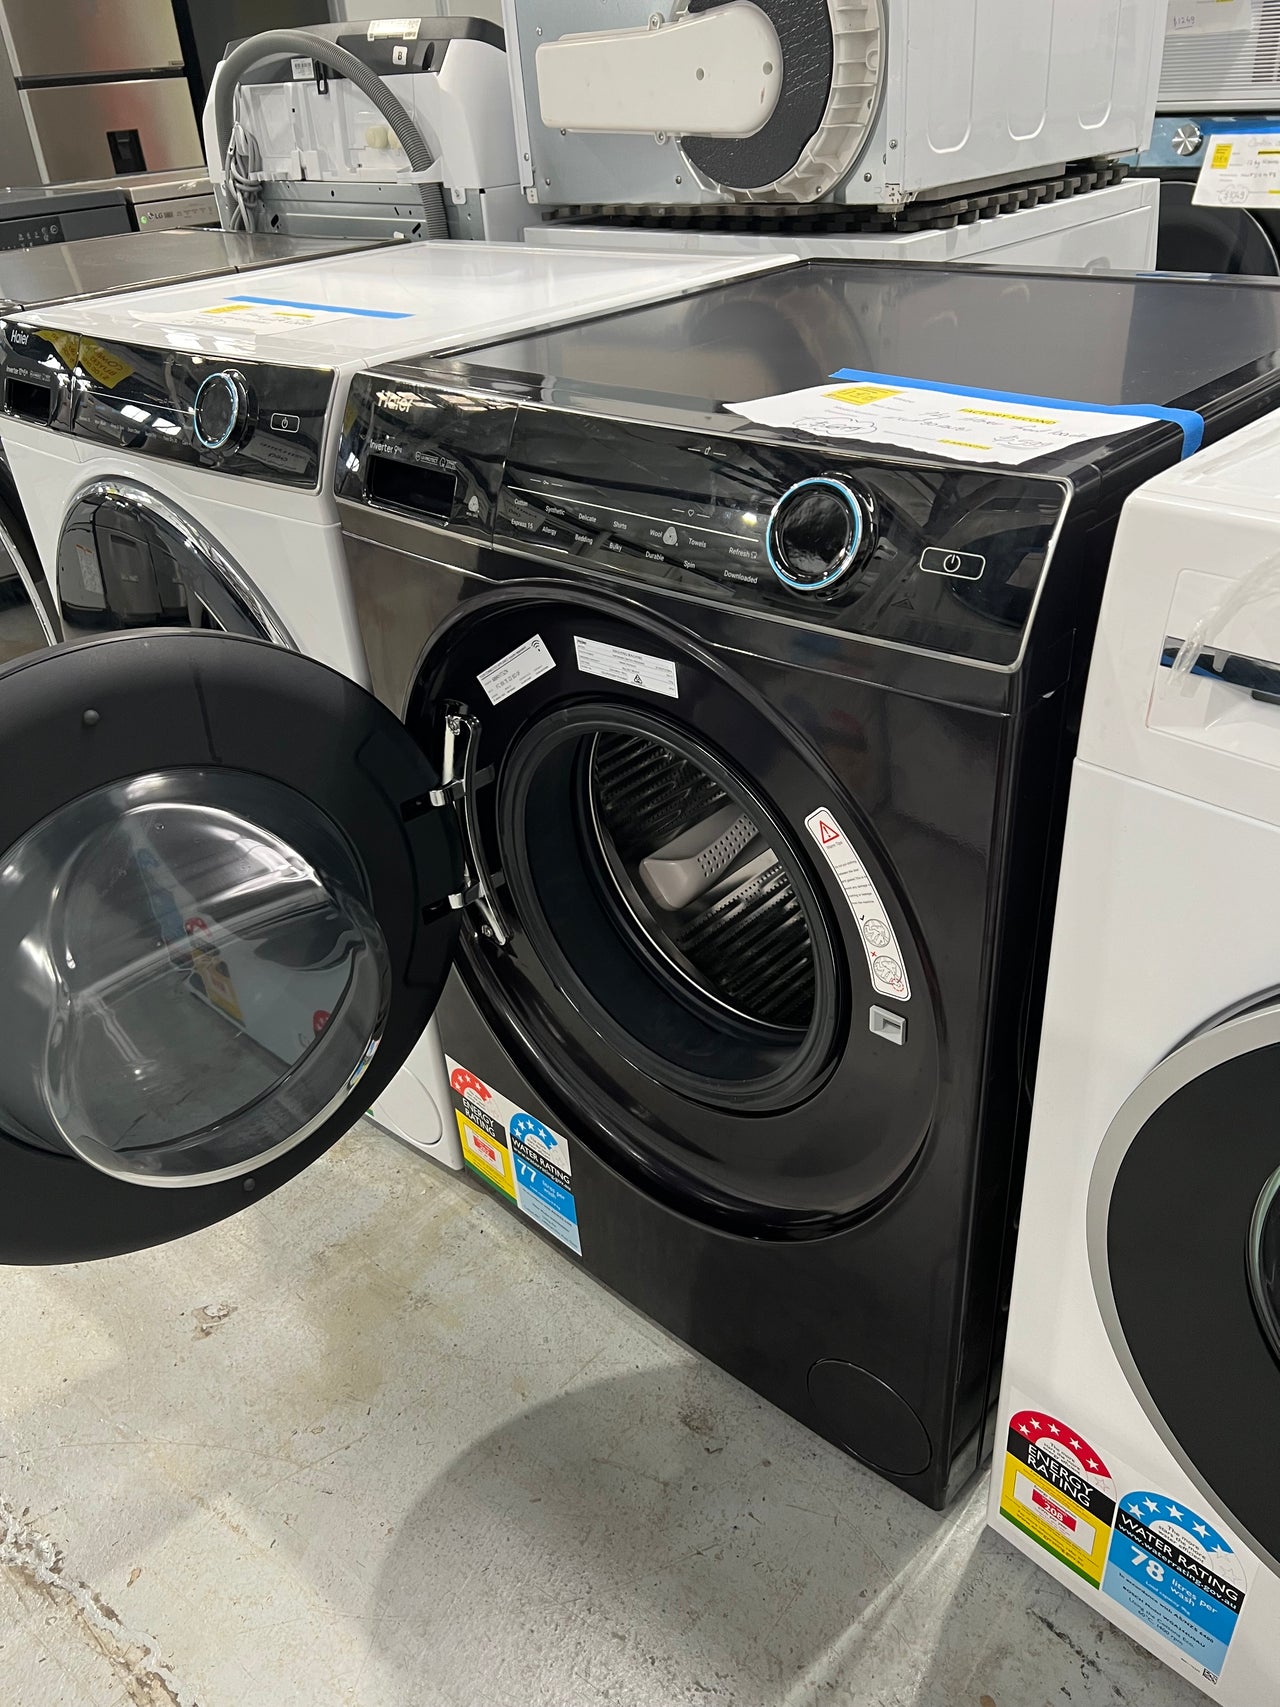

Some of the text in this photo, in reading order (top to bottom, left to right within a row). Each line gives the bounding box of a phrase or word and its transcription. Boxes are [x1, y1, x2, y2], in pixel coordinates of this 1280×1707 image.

[11, 329, 29, 345] Haier
[376, 389, 413, 413] Haier
[370, 438, 393, 453] Inverter
[545, 505, 565, 516] Synthetic
[578, 513, 597, 523] Delicate
[511, 518, 527, 528] Express
[542, 526, 557, 536] Allergy
[613, 520, 627, 530] Shirts
[574, 533, 593, 545] Bedding
[649, 529, 663, 538] Wool
[689, 537, 707, 548] Towels
[609, 541, 623, 553] Bulky
[645, 550, 665, 562] Durable
[729, 547, 750, 558] Refresh
[683, 560, 696, 569] Spin
[724, 569, 758, 584] Downloaded
[463, 1097, 495, 1127] ENERGY
[465, 1108, 496, 1138] RATING
[511, 1136, 540, 1163] WATER
[540, 1158, 570, 1185] RATING
[517, 1158, 536, 1183] 77
[1028, 1443, 1093, 1496] ENERGY
[1028, 1454, 1090, 1508] RATING
[1044, 1502, 1064, 1521] 208
[1158, 1525, 1206, 1560] stars the more
[1158, 1530, 1204, 1563] water efficient
[1168, 1525, 1200, 1550] The more
[1118, 1523, 1238, 1610] www.waterrating.gov.au
[1121, 1513, 1173, 1558] WATER
[1178, 1554, 1238, 1602] RATING
[1130, 1545, 1165, 1582] 78
[1170, 1586, 1196, 1607] wash
[1171, 1578, 1218, 1614] litres per
